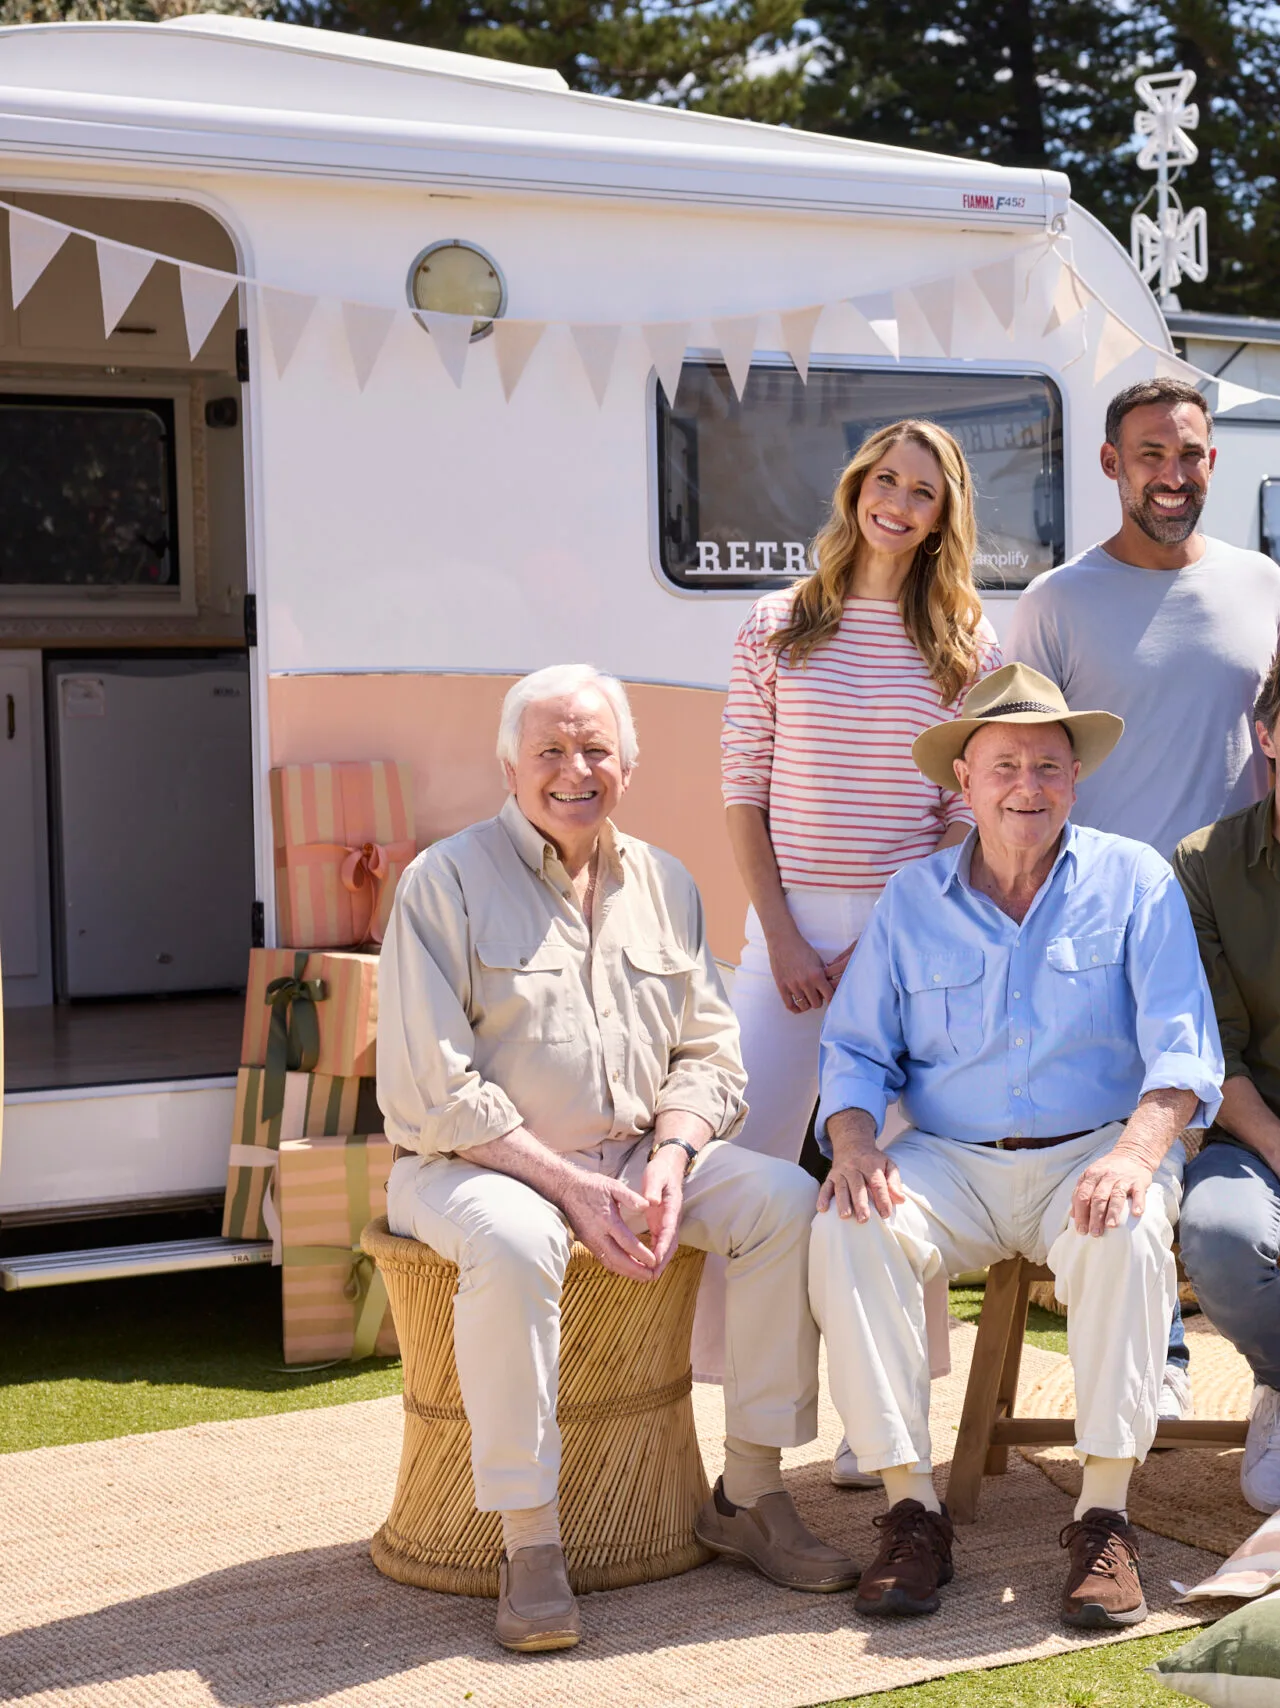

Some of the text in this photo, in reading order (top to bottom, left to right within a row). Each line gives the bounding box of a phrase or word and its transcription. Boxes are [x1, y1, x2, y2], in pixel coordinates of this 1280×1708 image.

[962, 194, 995, 210] FIAMMA
[695, 541, 821, 573] RETR
[972, 550, 1029, 569] amplify
